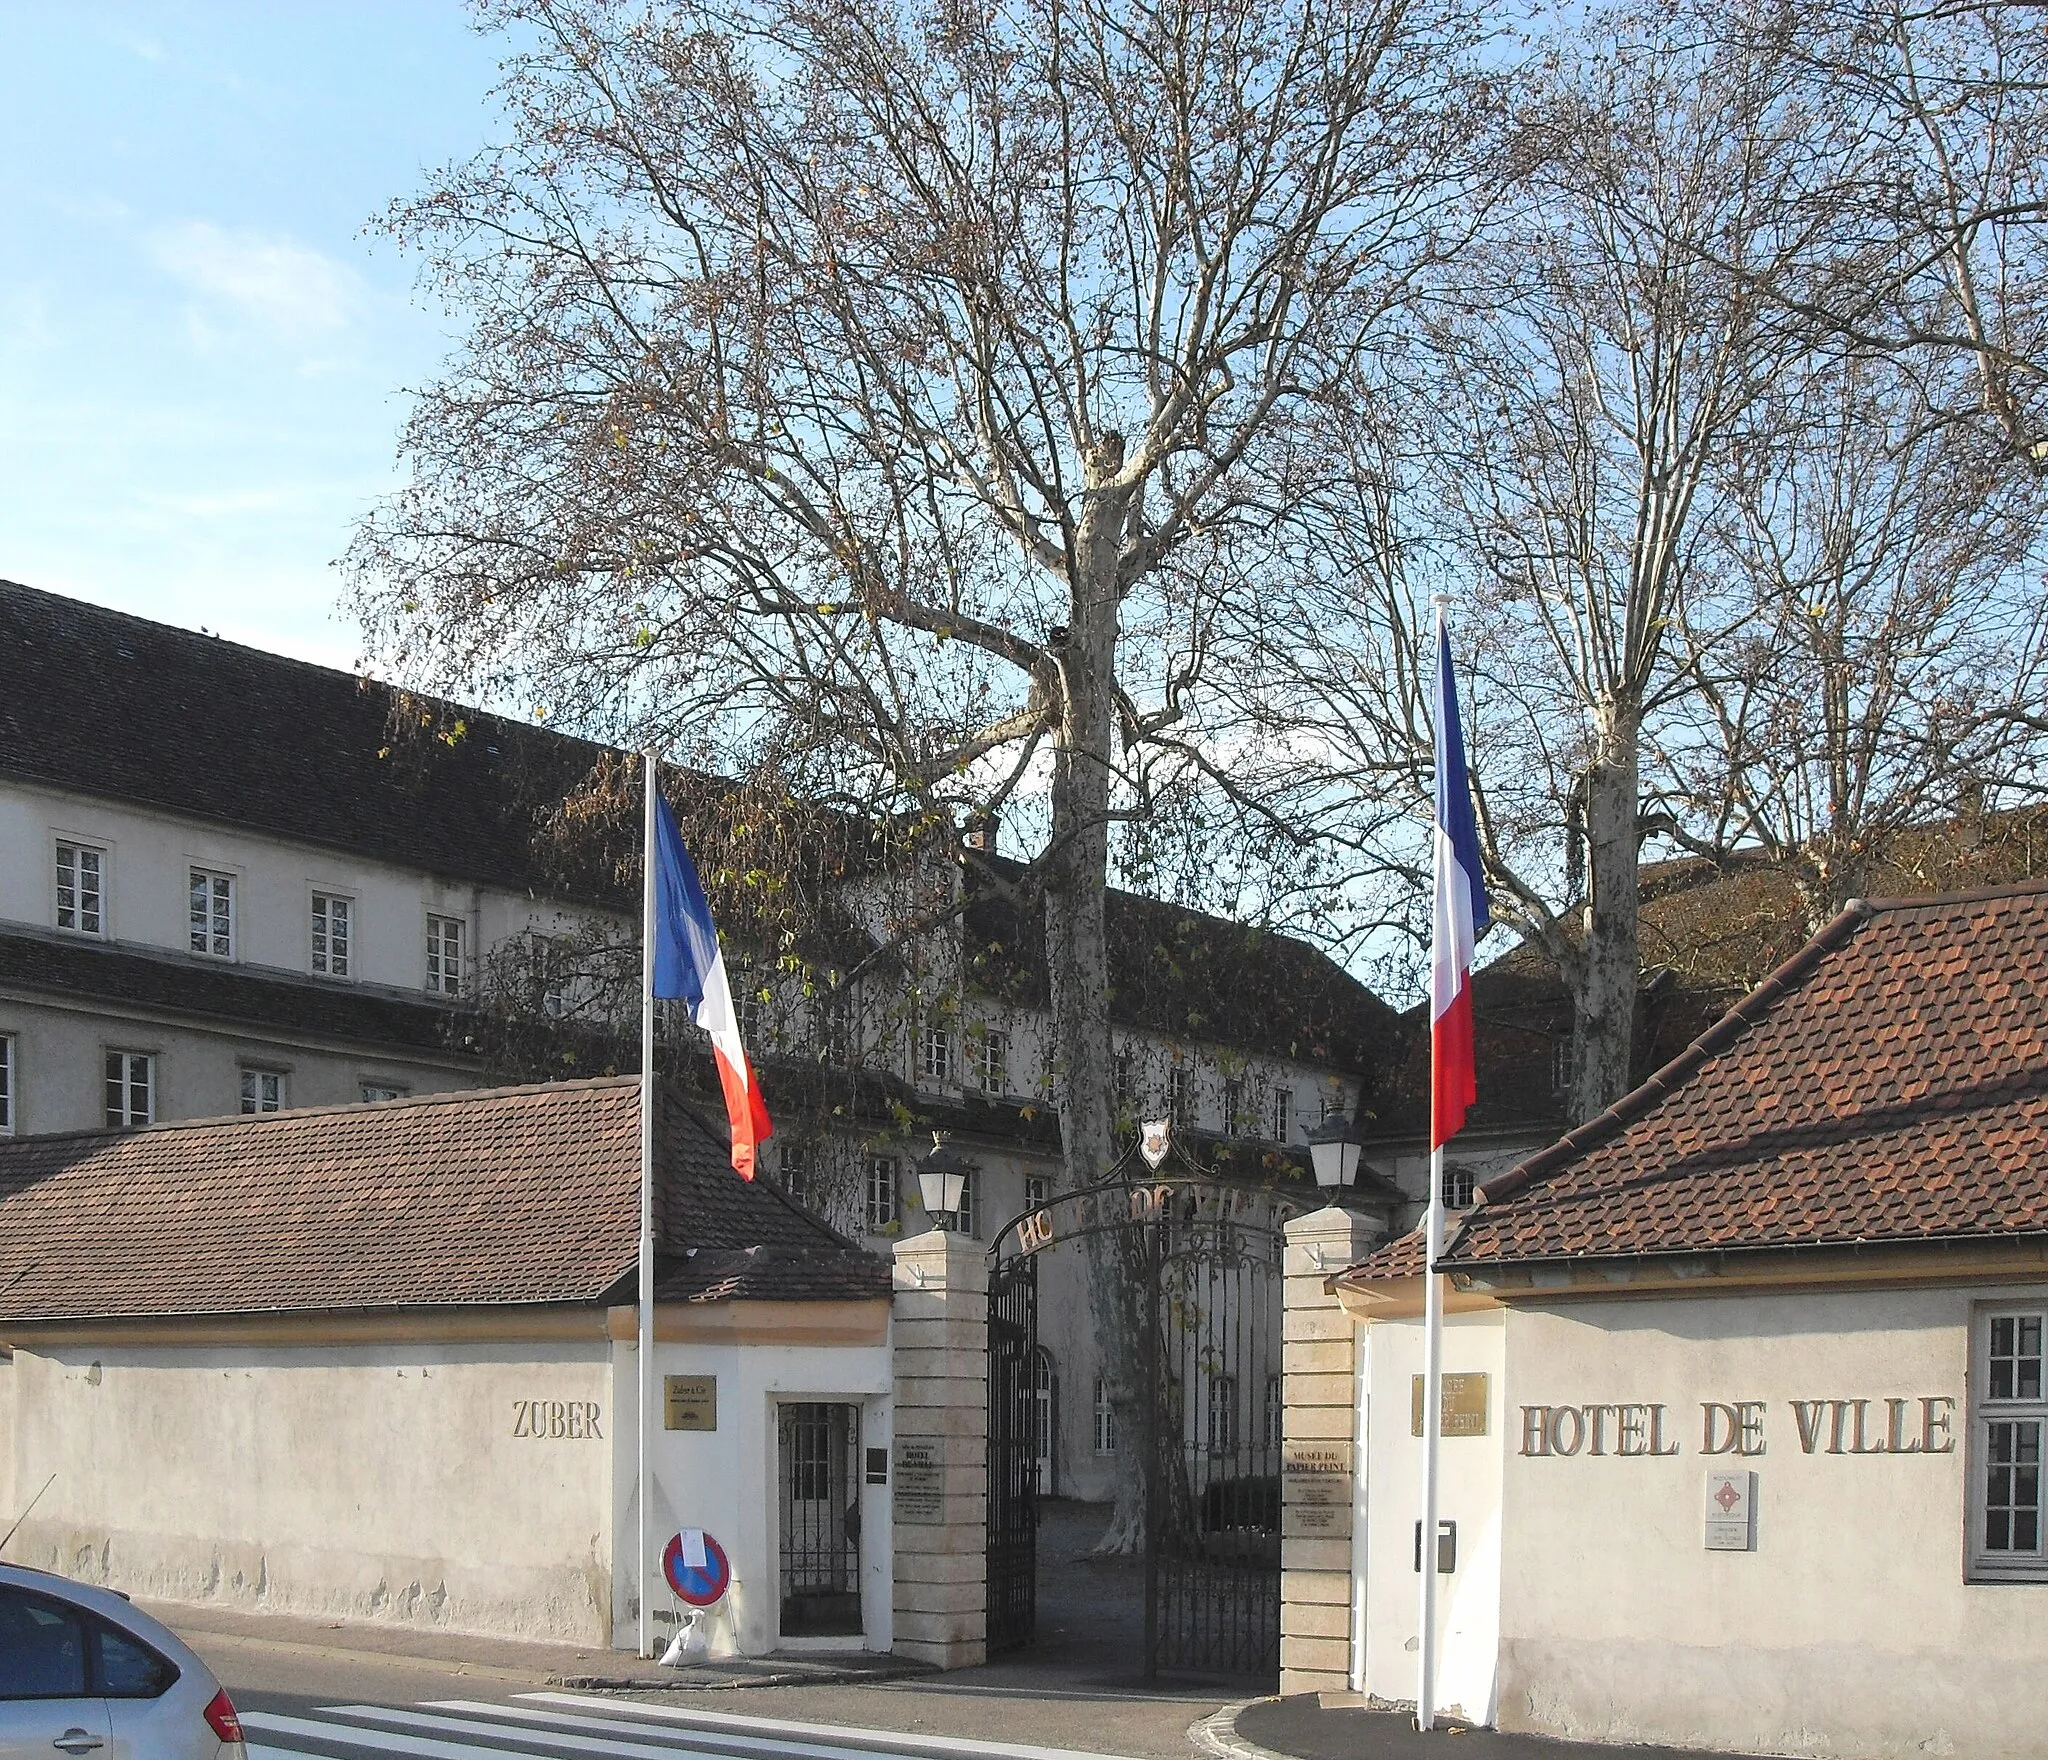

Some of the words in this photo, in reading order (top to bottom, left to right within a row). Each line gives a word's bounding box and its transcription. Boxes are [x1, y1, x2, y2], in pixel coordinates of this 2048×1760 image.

[512, 1400, 604, 1440] ZUBER
[1518, 1402, 1680, 1457] HOTEL
[1699, 1401, 1767, 1457] DE
[1789, 1396, 1956, 1455] VILLE
